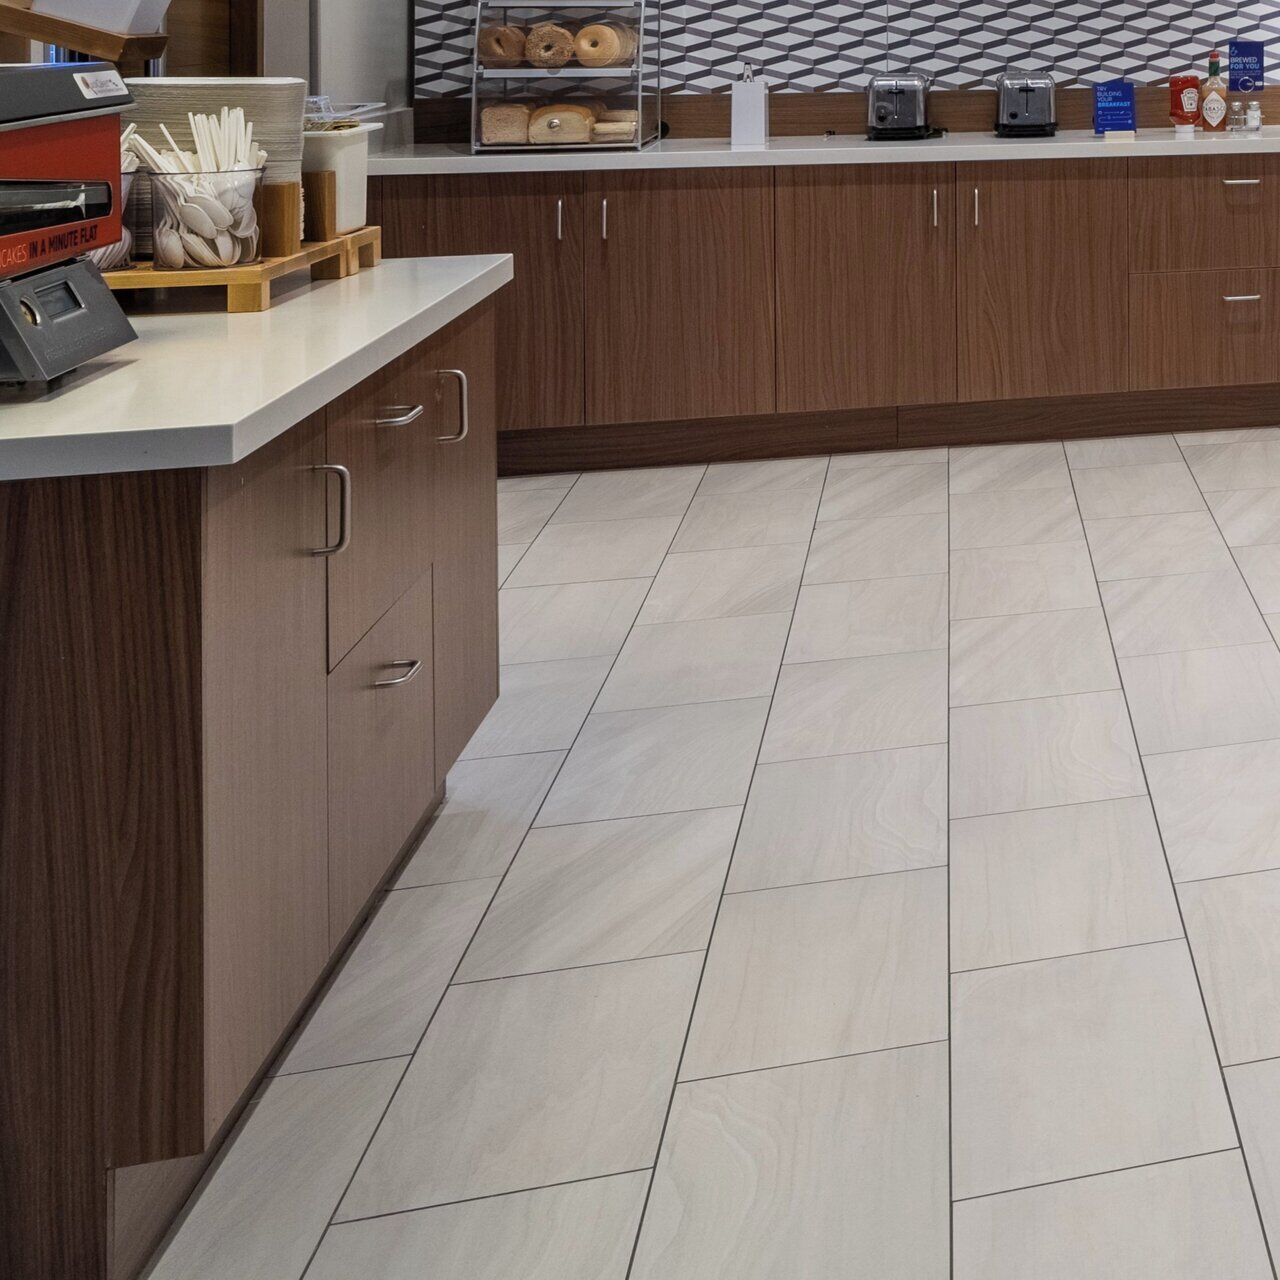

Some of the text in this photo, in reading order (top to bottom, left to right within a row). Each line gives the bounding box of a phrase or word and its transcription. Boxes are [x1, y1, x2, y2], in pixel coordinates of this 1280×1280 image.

[1230, 56, 1258, 64] BREWED
[0, 224, 98, 268] CAKES IN A MINUTE FLAT
